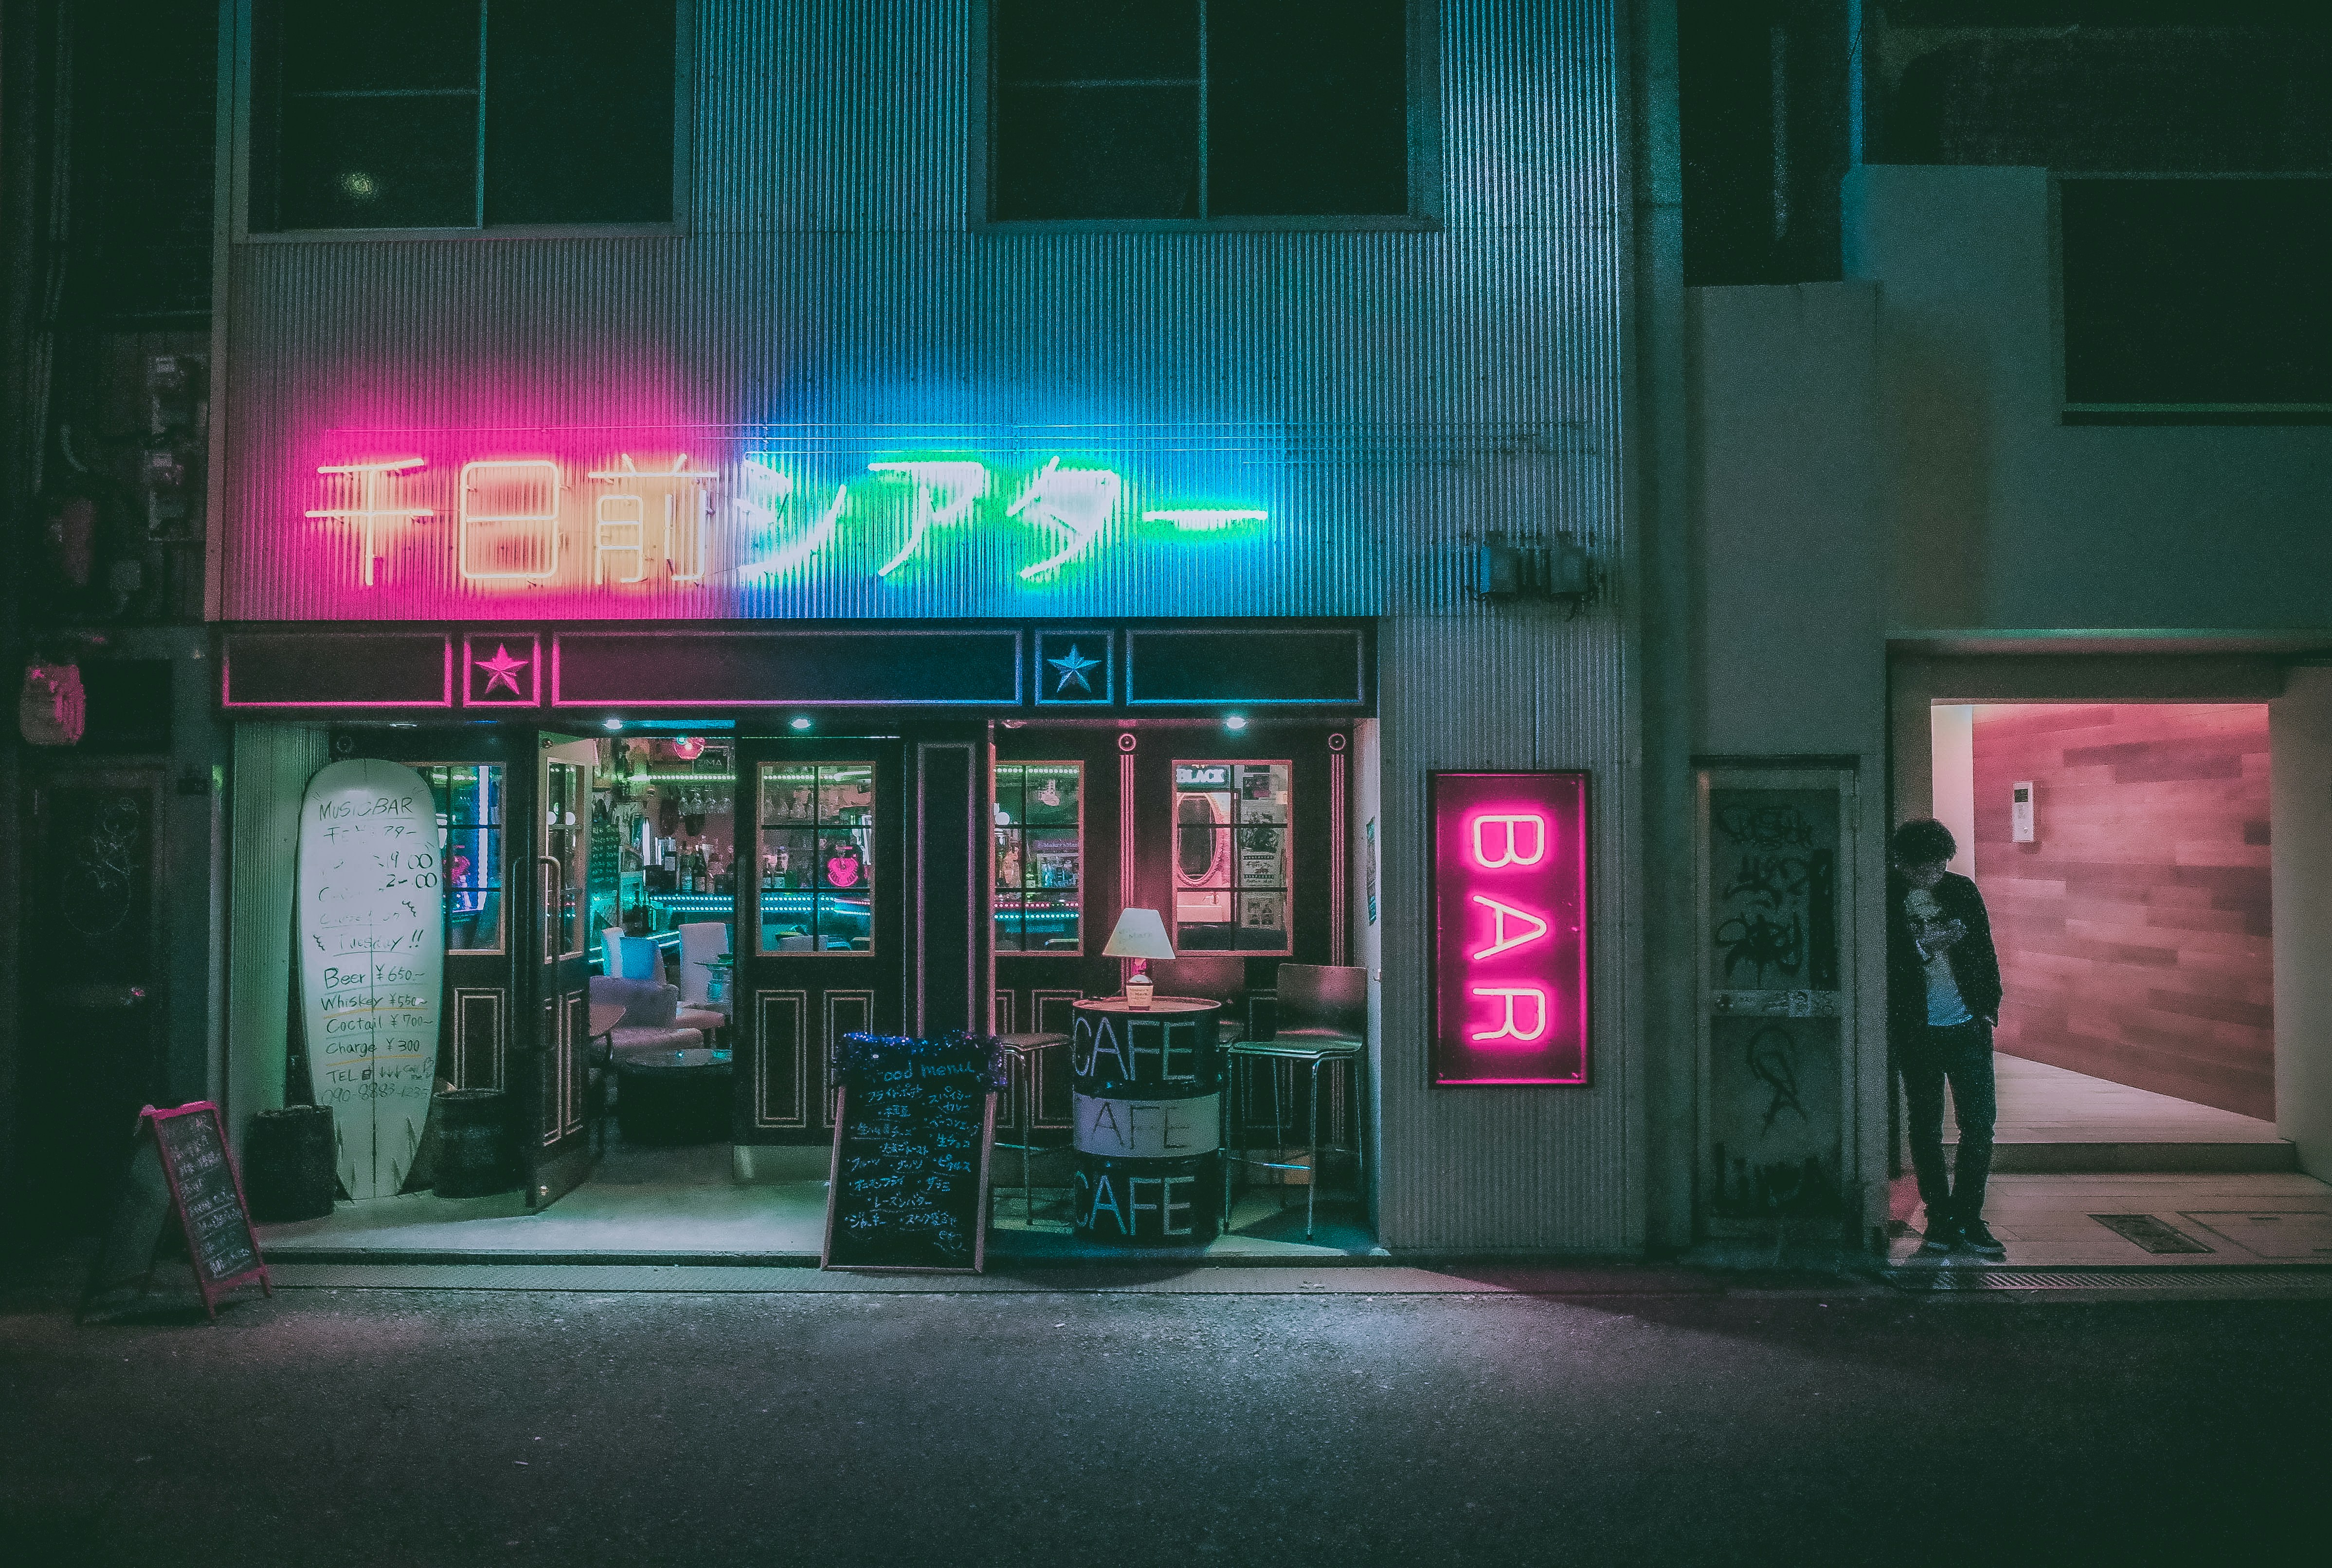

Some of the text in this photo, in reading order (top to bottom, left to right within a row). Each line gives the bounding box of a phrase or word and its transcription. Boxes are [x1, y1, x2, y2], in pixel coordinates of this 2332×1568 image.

[305, 451, 1268, 586] 千日前シアター
[1176, 768, 1225, 783] BLACK
[1472, 814, 1547, 1041] BAR
[324, 967, 366, 989] Beer
[321, 994, 383, 1011] Whiskey
[326, 1015, 382, 1033] Coctail
[325, 1042, 377, 1058] Charge
[1073, 1017, 1195, 1081] CAFE
[326, 1069, 358, 1084] TEL
[877, 1060, 913, 1082] ood
[1091, 1100, 1191, 1150] AFE
